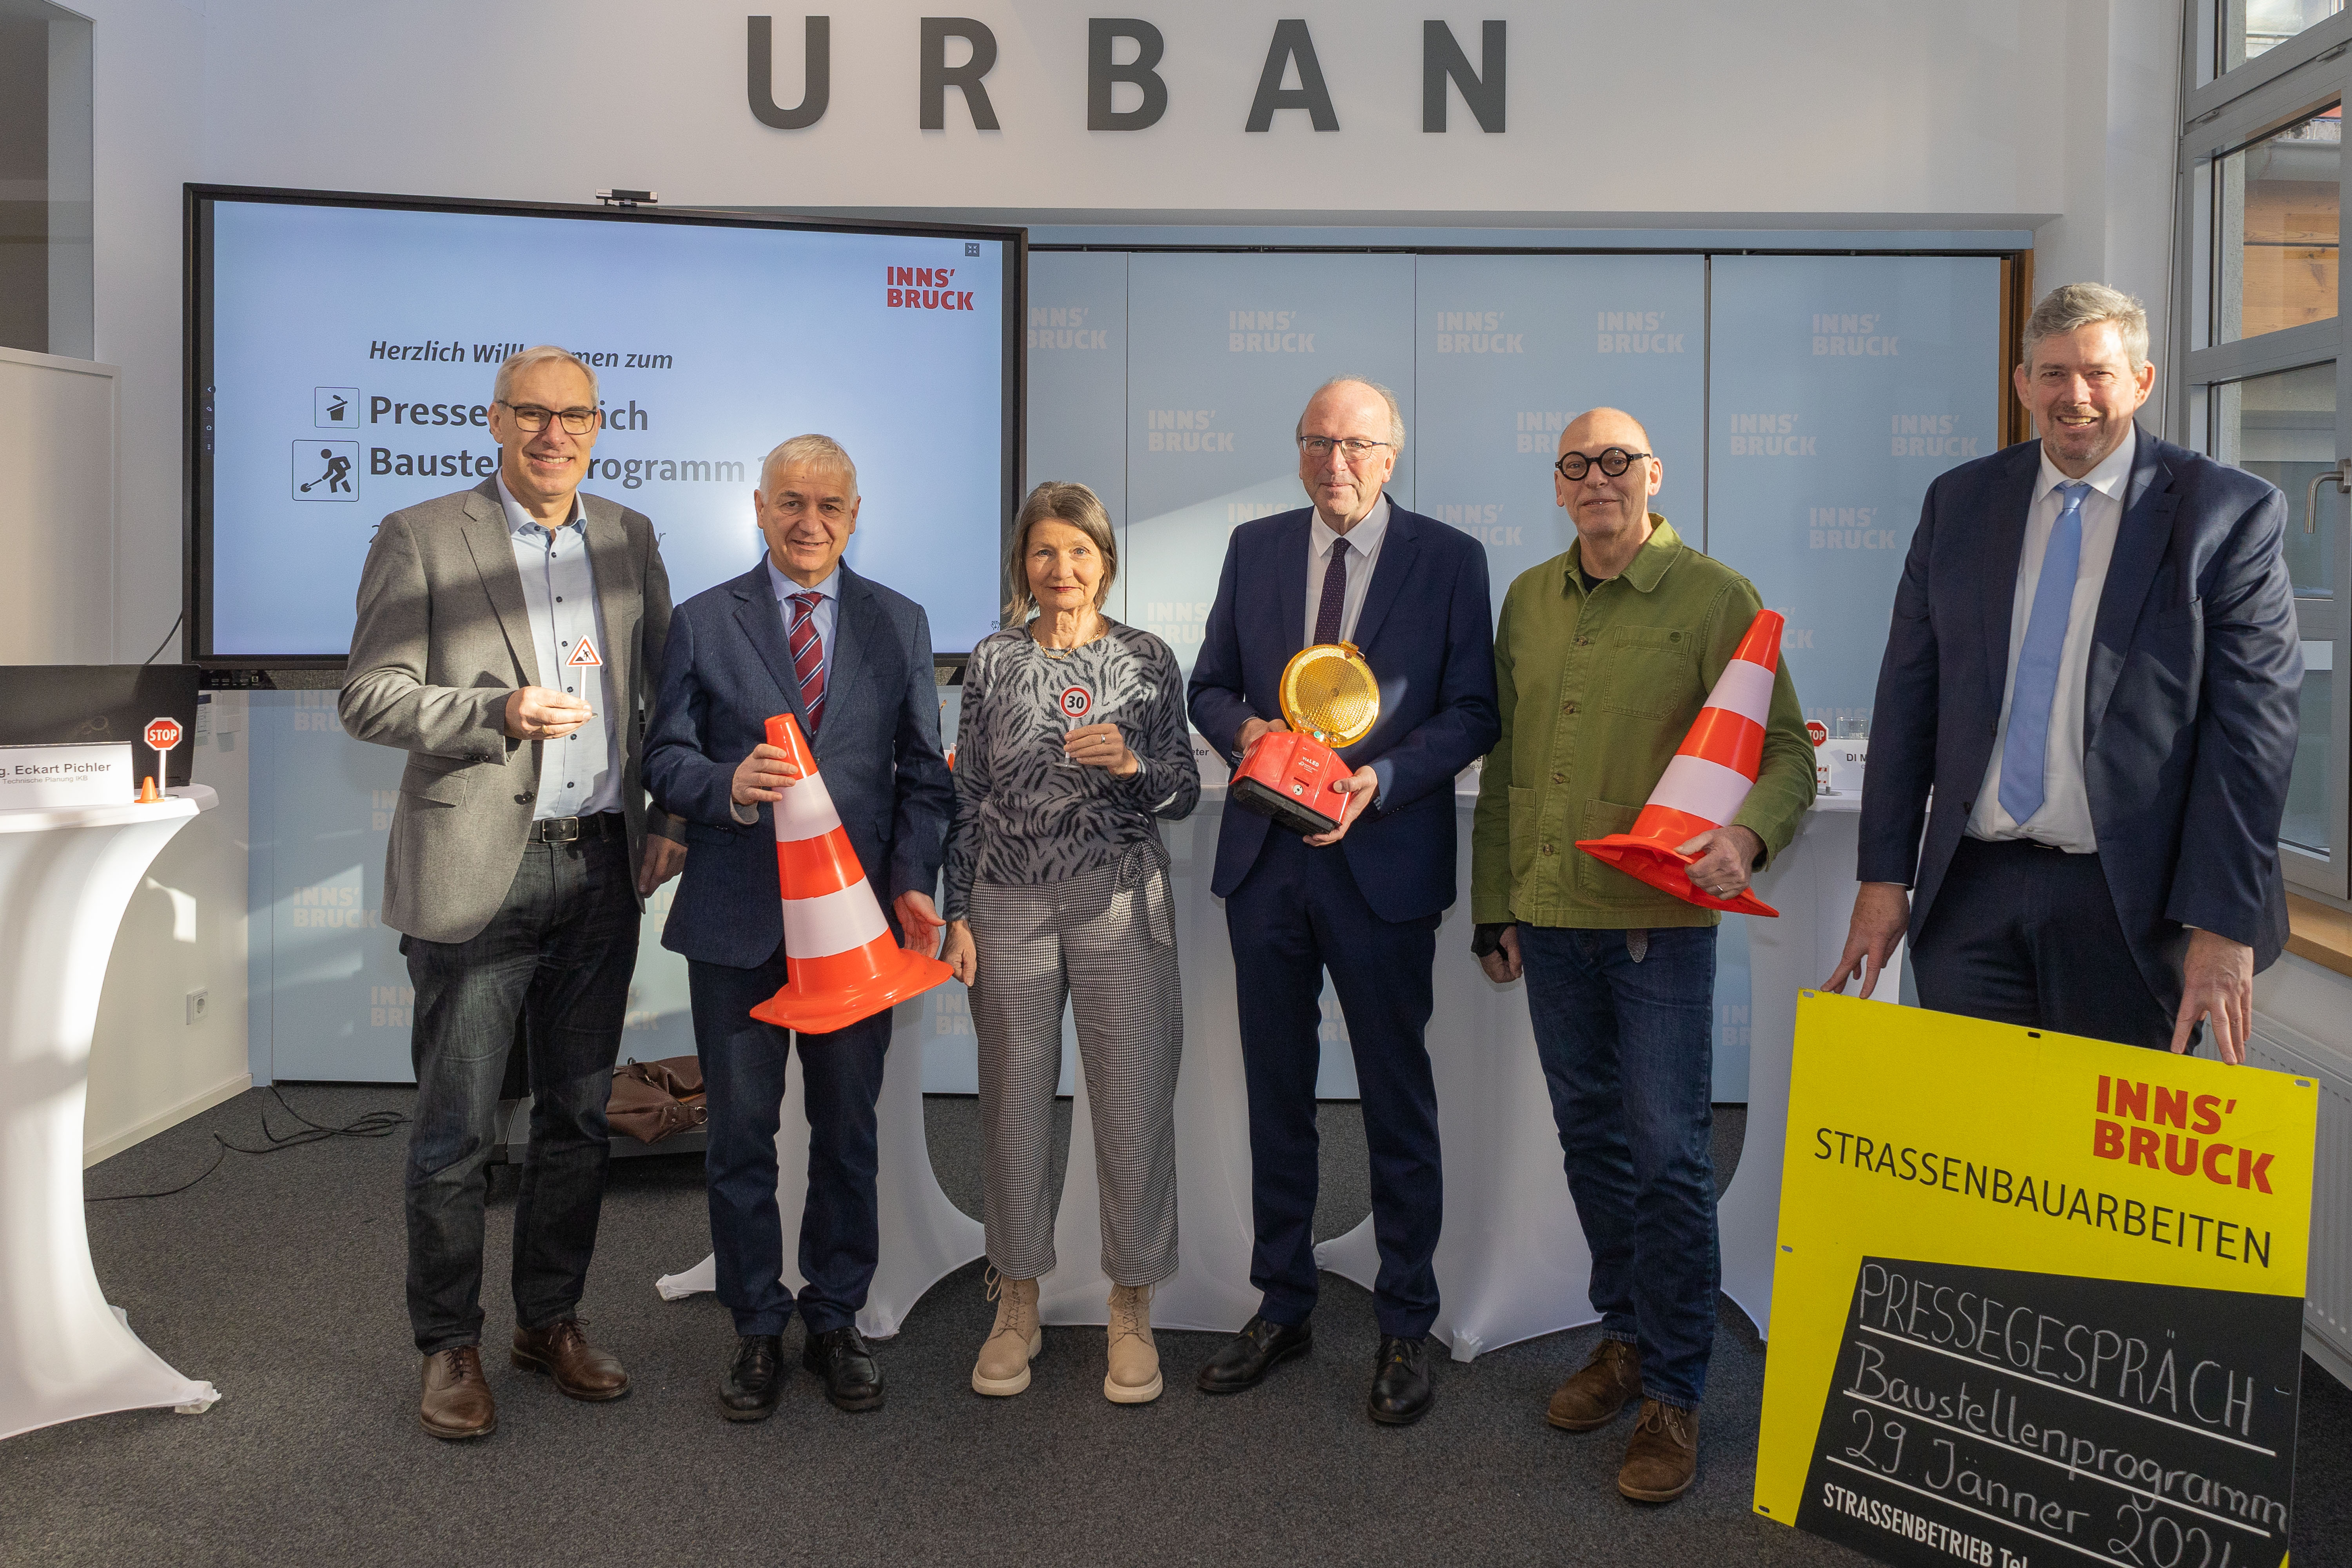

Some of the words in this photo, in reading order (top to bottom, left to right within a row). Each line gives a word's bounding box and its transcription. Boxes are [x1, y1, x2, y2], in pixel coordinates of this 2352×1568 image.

[747, 15, 1507, 133] URBAN
[887, 266, 955, 288] INNS'
[887, 289, 974, 310] BRUCK
[1031, 307, 1089, 327] NNS'
[1229, 333, 1315, 352] BRUCK
[1437, 334, 1524, 353] BRUCK
[1598, 334, 1685, 353] BRUCK
[1812, 336, 1899, 356] BRUCK
[370, 340, 465, 362] Herzlich
[624, 353, 673, 369] zum
[1149, 432, 1234, 452] BRUCK
[1731, 436, 1817, 456] BRUCK
[1891, 437, 1978, 457] BRUCK
[371, 447, 745, 489] Baustelrogramm
[1809, 530, 1896, 549] BRUCK
[1067, 695, 1084, 709] 30
[150, 729, 177, 741] STOP
[1808, 730, 1825, 740] TOP
[1847, 753, 1857, 762] DI
[0, 768, 10, 778] g.
[15, 764, 60, 775] Eckart
[64, 762, 111, 773] Pichler
[294, 908, 377, 929] BRUCK
[2096, 1075, 2236, 1134] INNS'
[2093, 1119, 2275, 1194] BRUCK
[1814, 1127, 2270, 1269] STRASSENBAUARBEITEN
[1860, 1263, 2254, 1436] PRESSEGESPRÄCH
[1849, 1341, 2287, 1533] Baustellenprogramm
[1925, 1439, 2090, 1533] Jänner
[2108, 1504, 2231, 1568] 202
[1823, 1482, 1993, 1567] STRASSENBETRIEB
